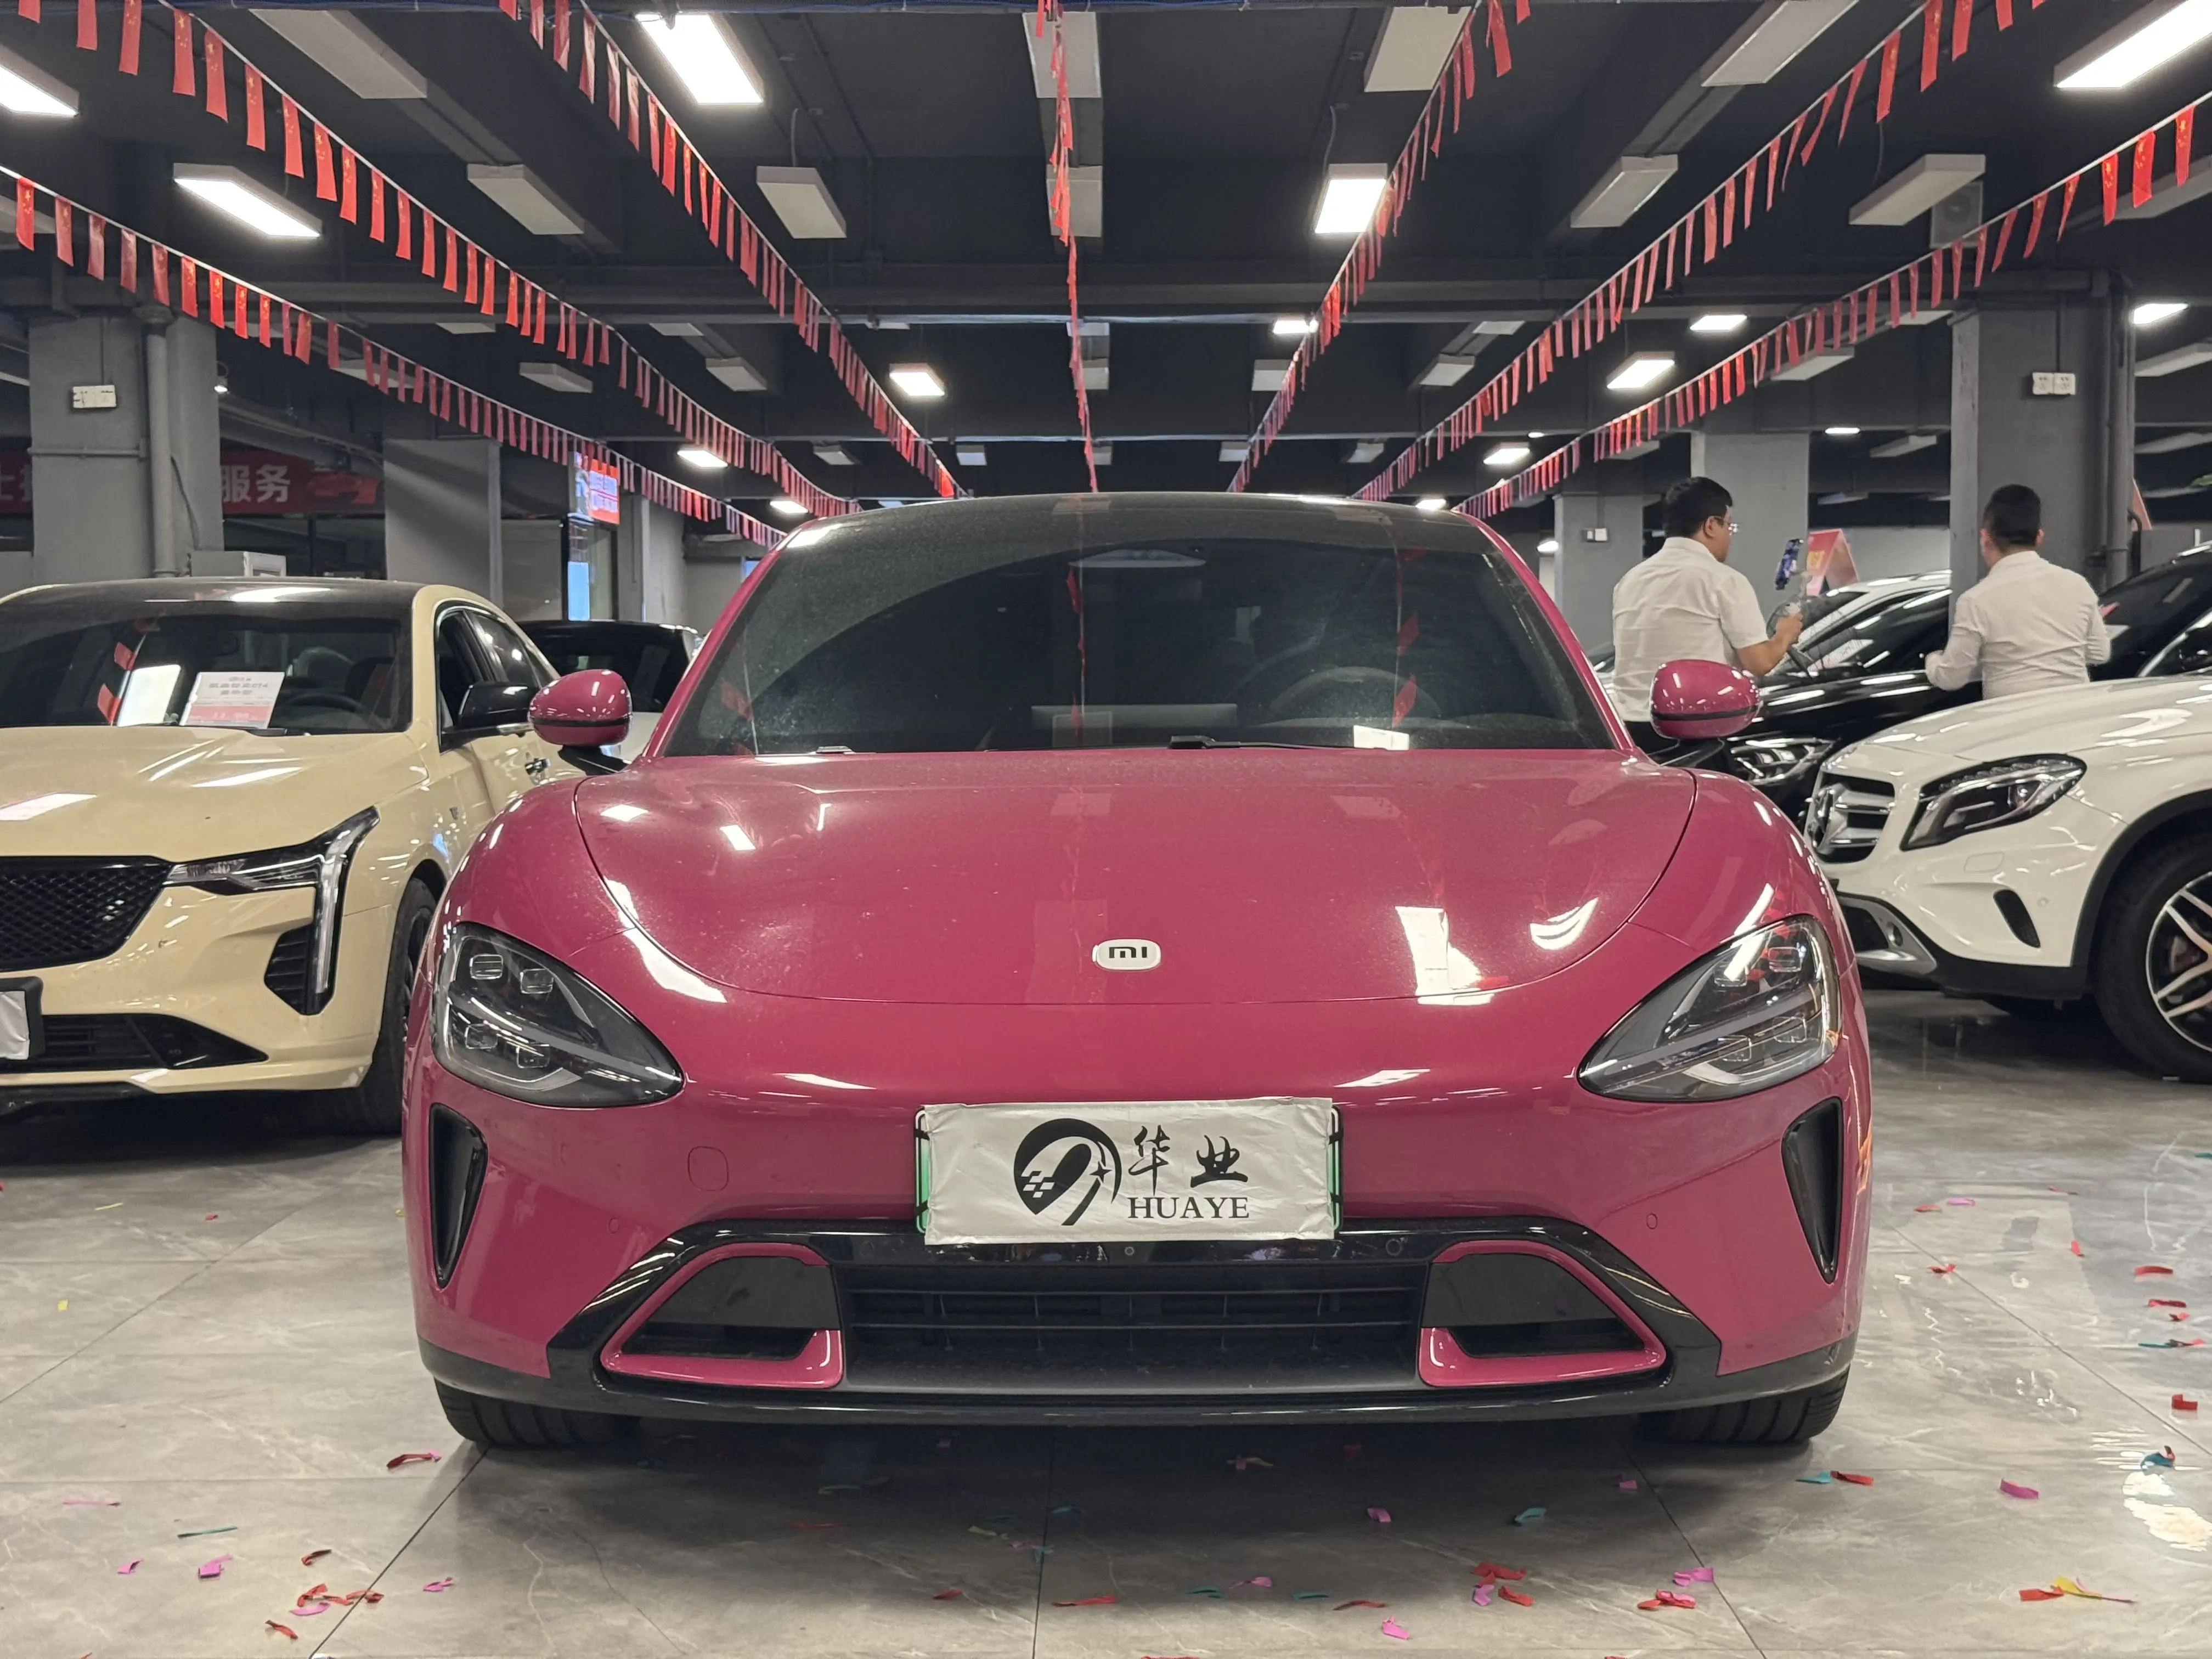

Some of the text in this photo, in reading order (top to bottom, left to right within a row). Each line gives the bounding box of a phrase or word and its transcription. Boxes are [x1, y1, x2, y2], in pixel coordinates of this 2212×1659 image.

[221, 465, 290, 503] 服务
[1128, 1125, 1248, 1197] 华业
[1127, 1197, 1250, 1218] HUAYE
